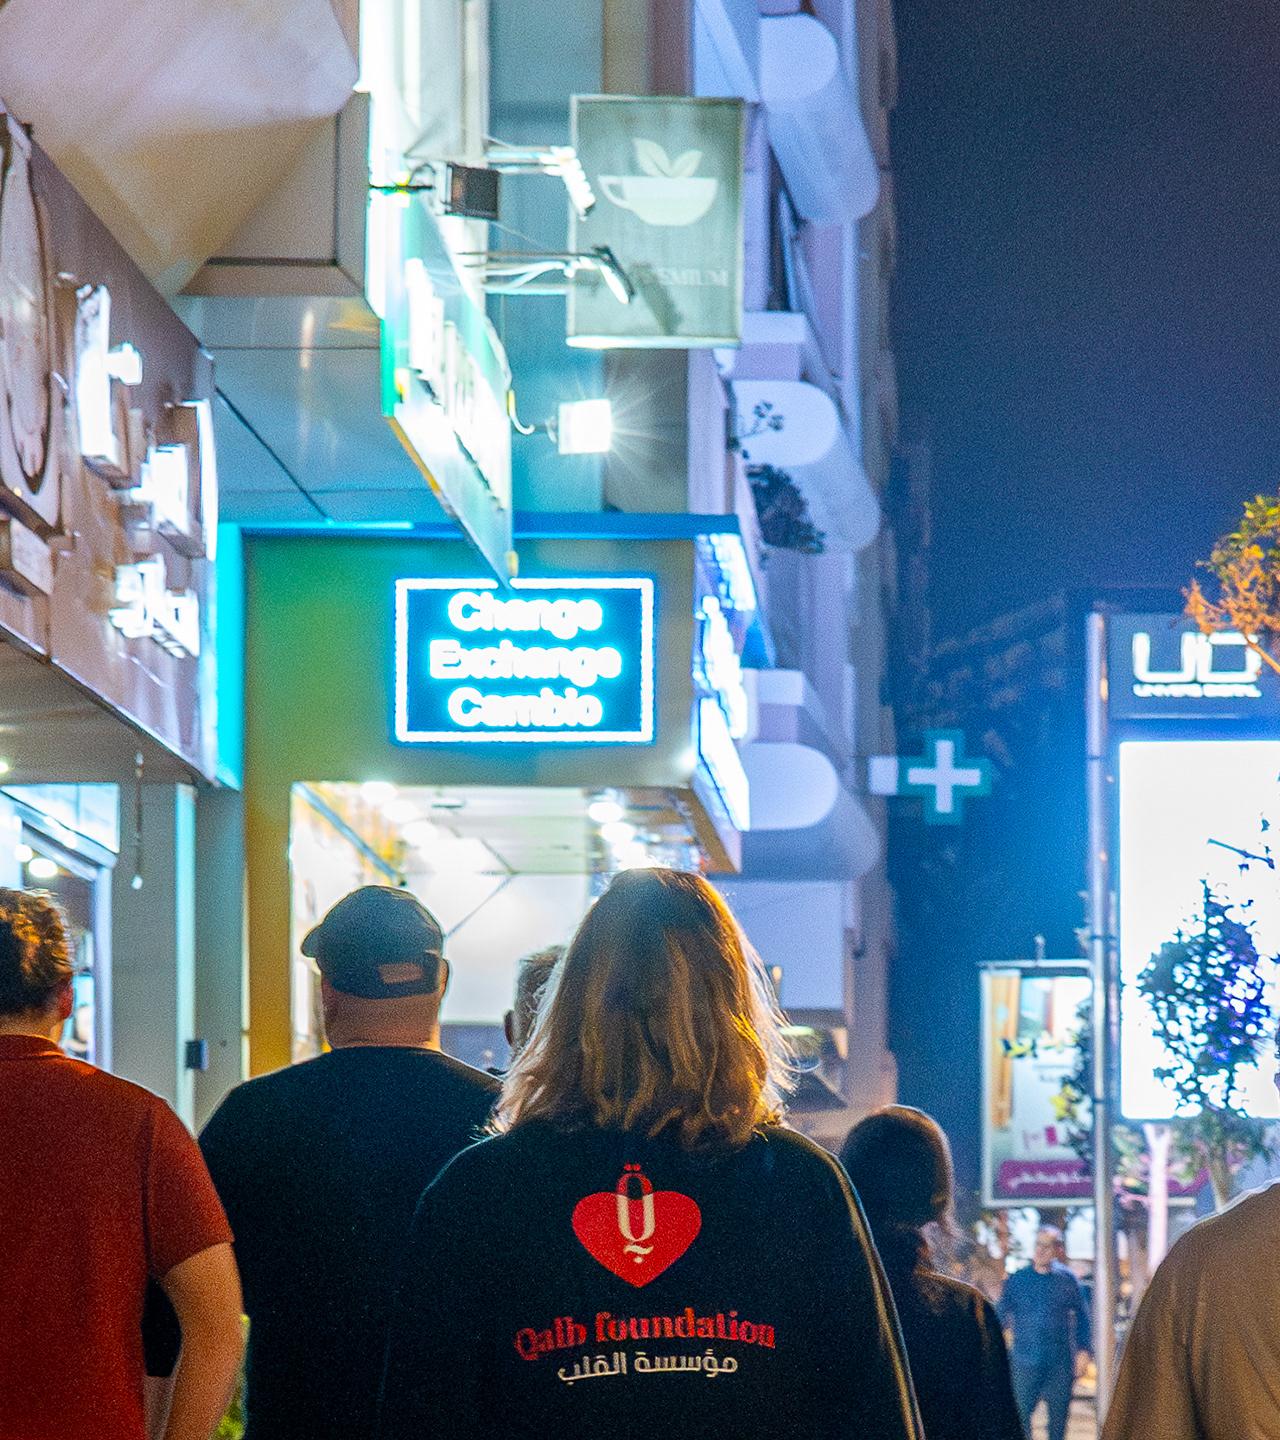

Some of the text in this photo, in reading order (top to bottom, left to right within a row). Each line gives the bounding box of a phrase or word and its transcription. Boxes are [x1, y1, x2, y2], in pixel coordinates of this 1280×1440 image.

[447, 591, 603, 640] Change
[429, 639, 622, 688] Exchange
[447, 686, 603, 727] Cambio
[513, 1307, 775, 1361] Qalb foundation
[557, 1349, 738, 1385] مؤسسة القلب
